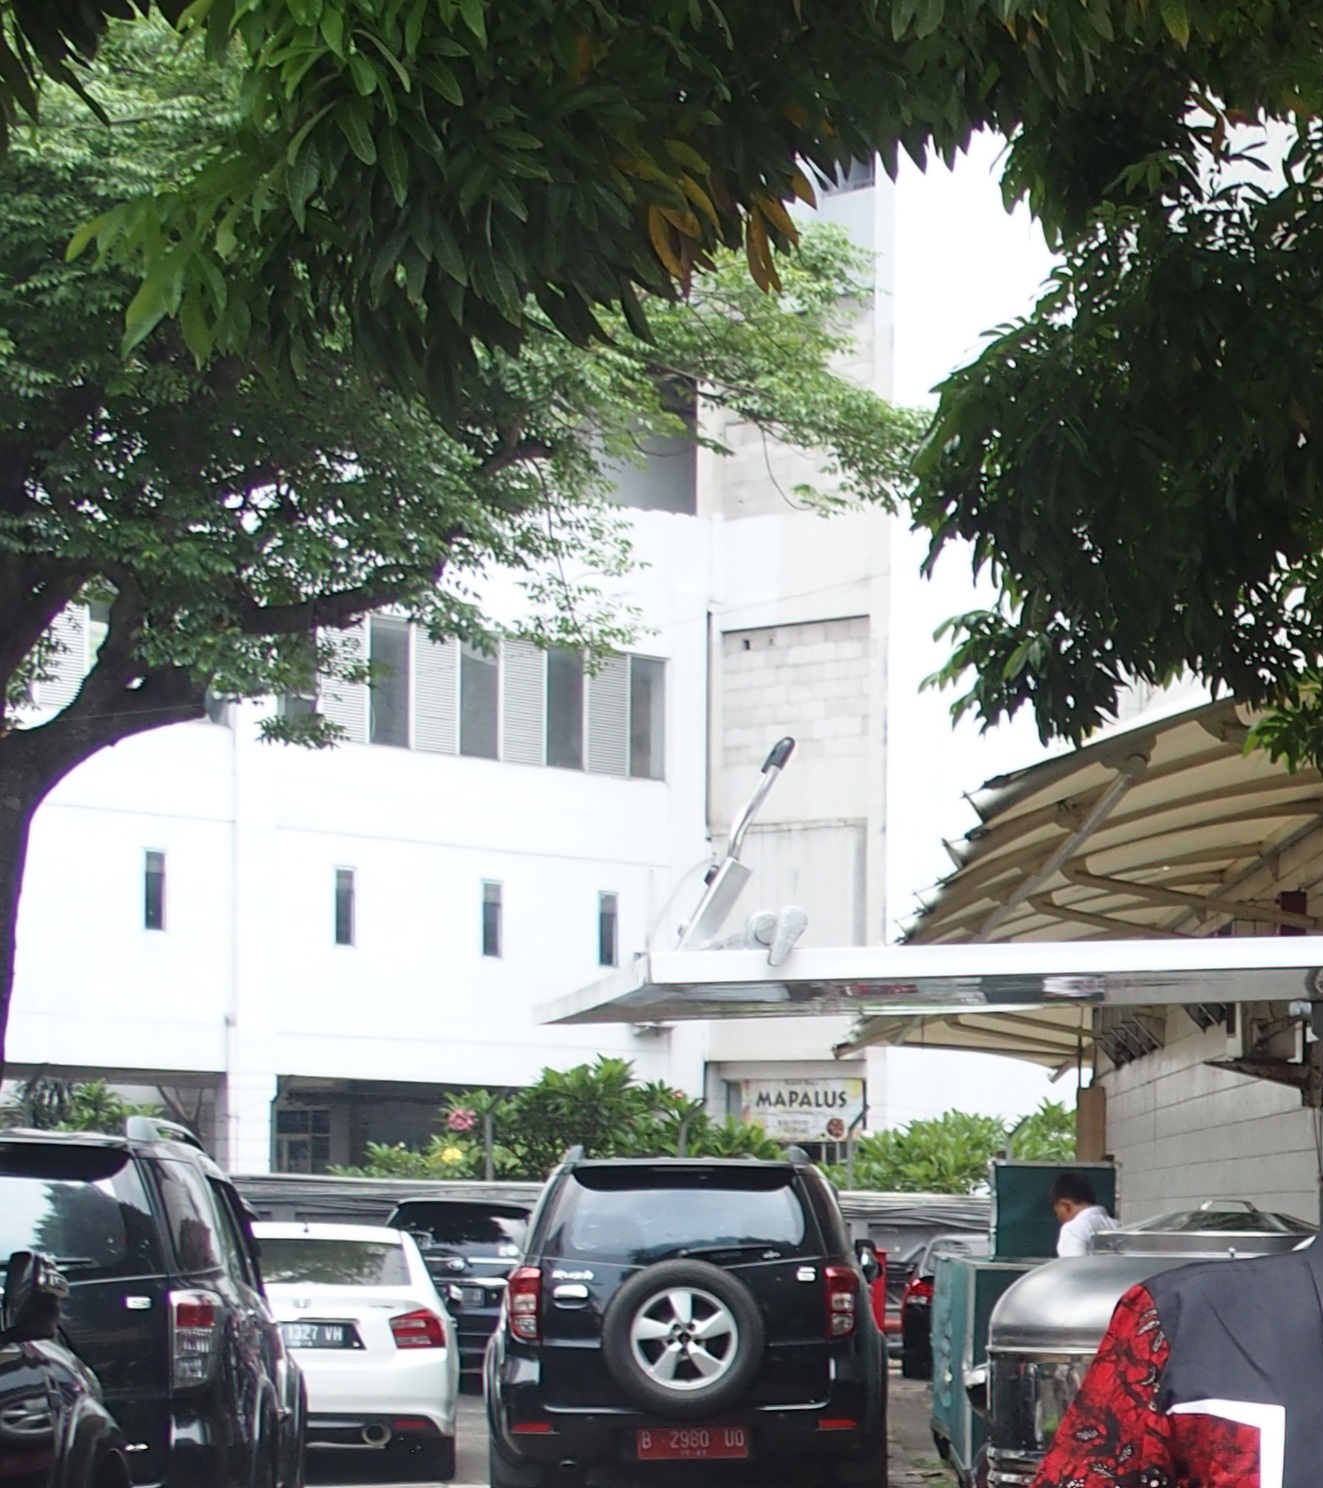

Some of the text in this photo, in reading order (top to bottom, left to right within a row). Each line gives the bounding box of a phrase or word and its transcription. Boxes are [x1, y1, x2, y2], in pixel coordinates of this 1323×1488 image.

[755, 1091, 847, 1108] MAPALUS
[641, 1431, 651, 1449] B
[670, 1431, 709, 1448] 2980
